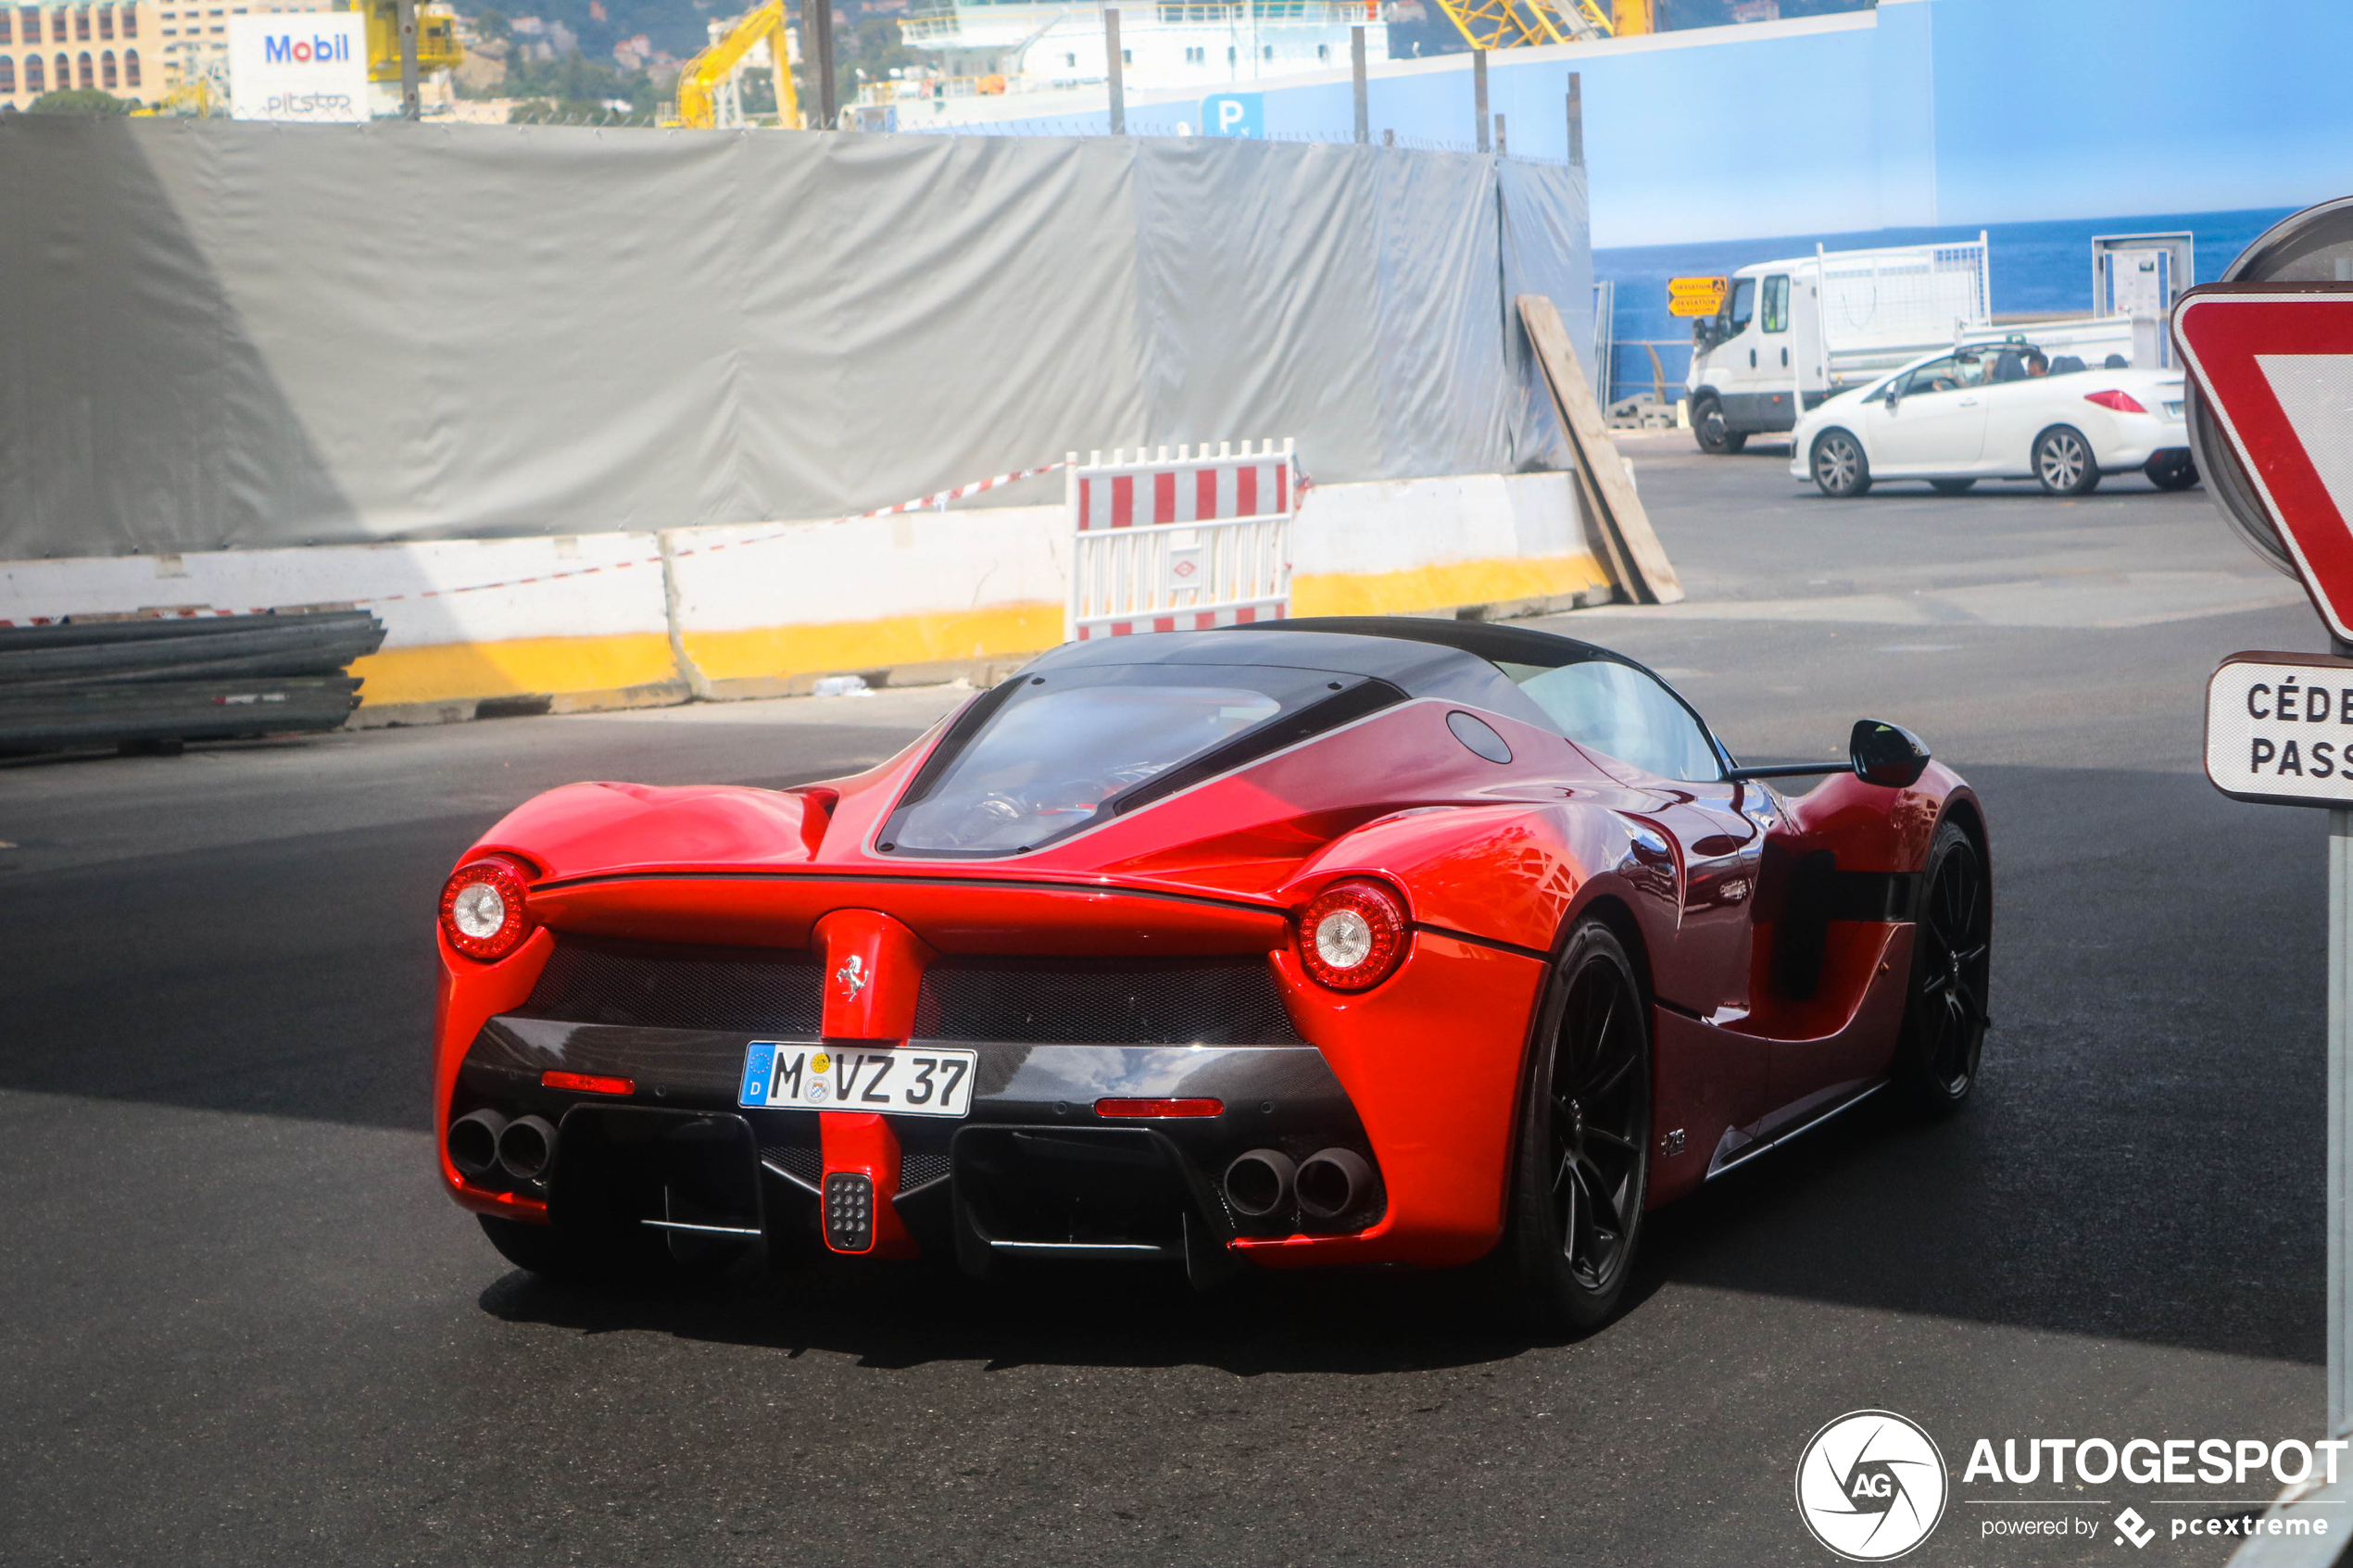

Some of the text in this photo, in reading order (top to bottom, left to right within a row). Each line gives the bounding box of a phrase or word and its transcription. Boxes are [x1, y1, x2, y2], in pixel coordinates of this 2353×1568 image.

[265, 33, 349, 63] Mobil
[1219, 100, 1243, 134] P
[2247, 676, 2353, 725] CÉDE
[749, 1081, 761, 1096] D
[771, 1052, 969, 1107] M VZ 37
